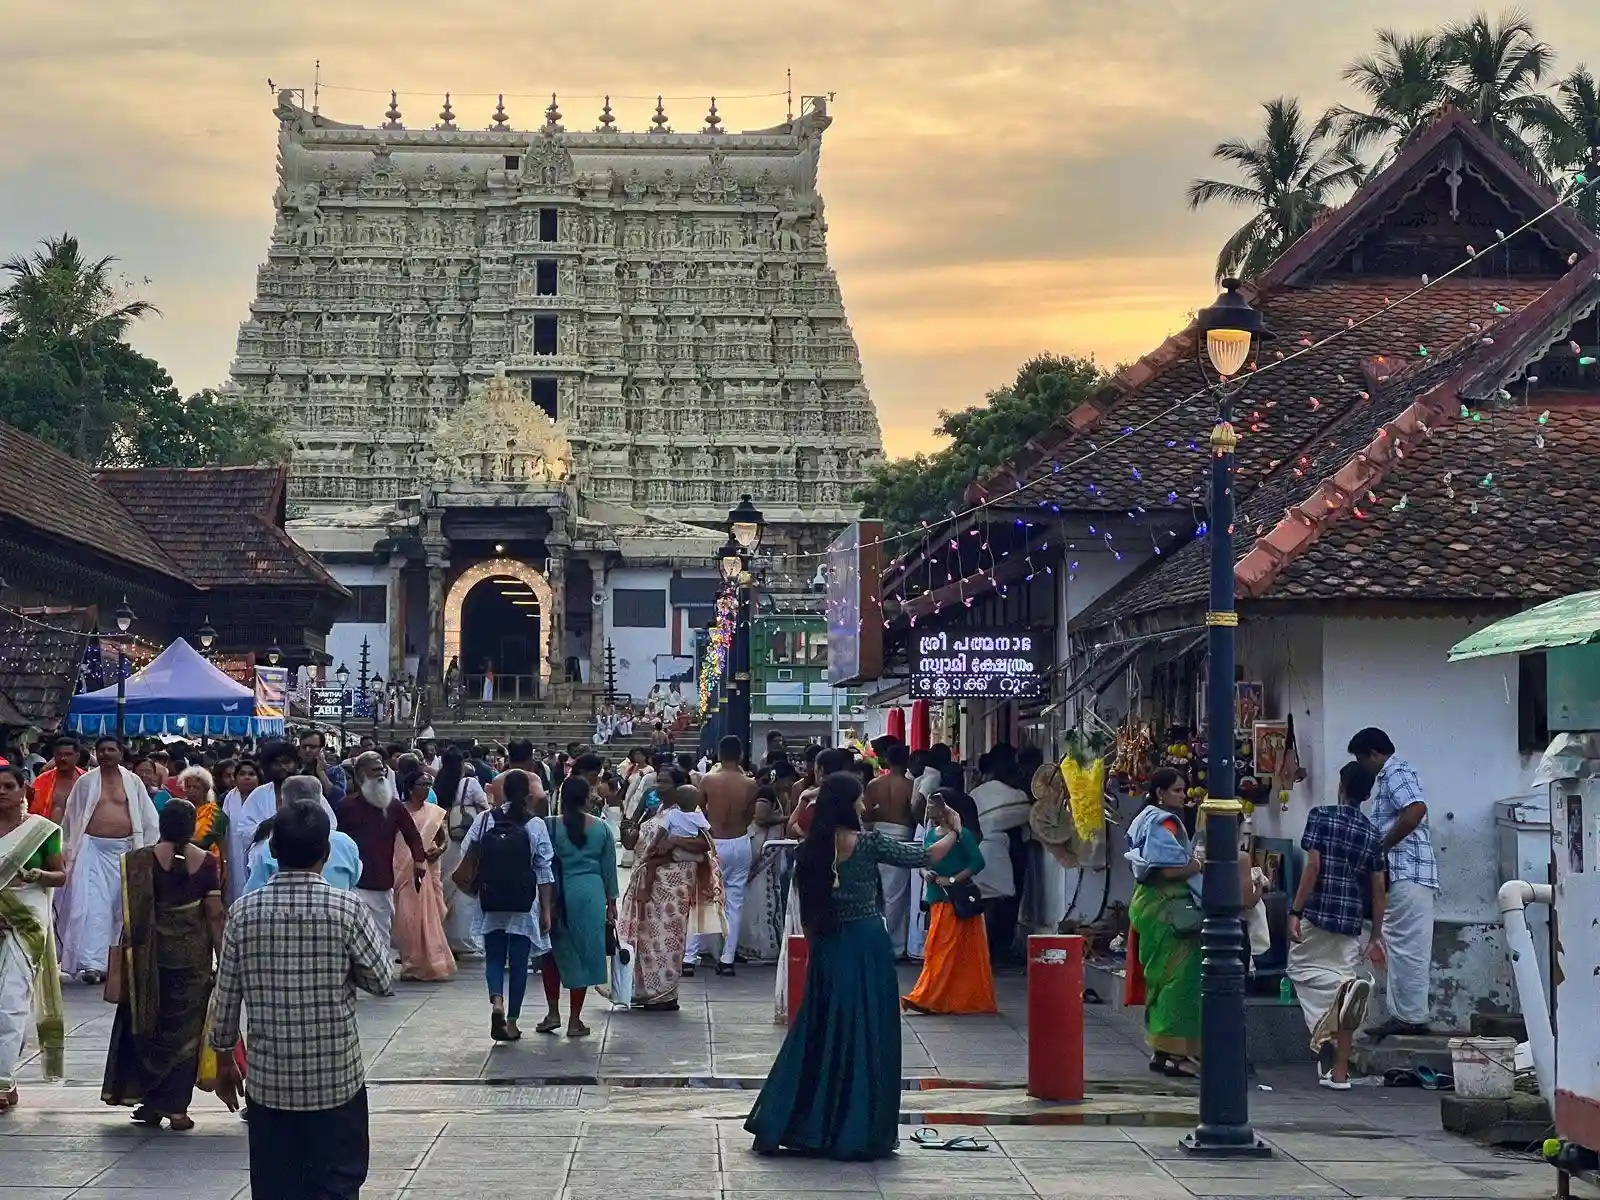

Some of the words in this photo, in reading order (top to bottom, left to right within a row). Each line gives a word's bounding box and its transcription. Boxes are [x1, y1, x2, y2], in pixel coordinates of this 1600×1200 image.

[920, 631, 947, 654] ശ്രീ
[920, 653, 967, 674] സ്വാമി
[971, 657, 1034, 676] ക്ഷേത്രം
